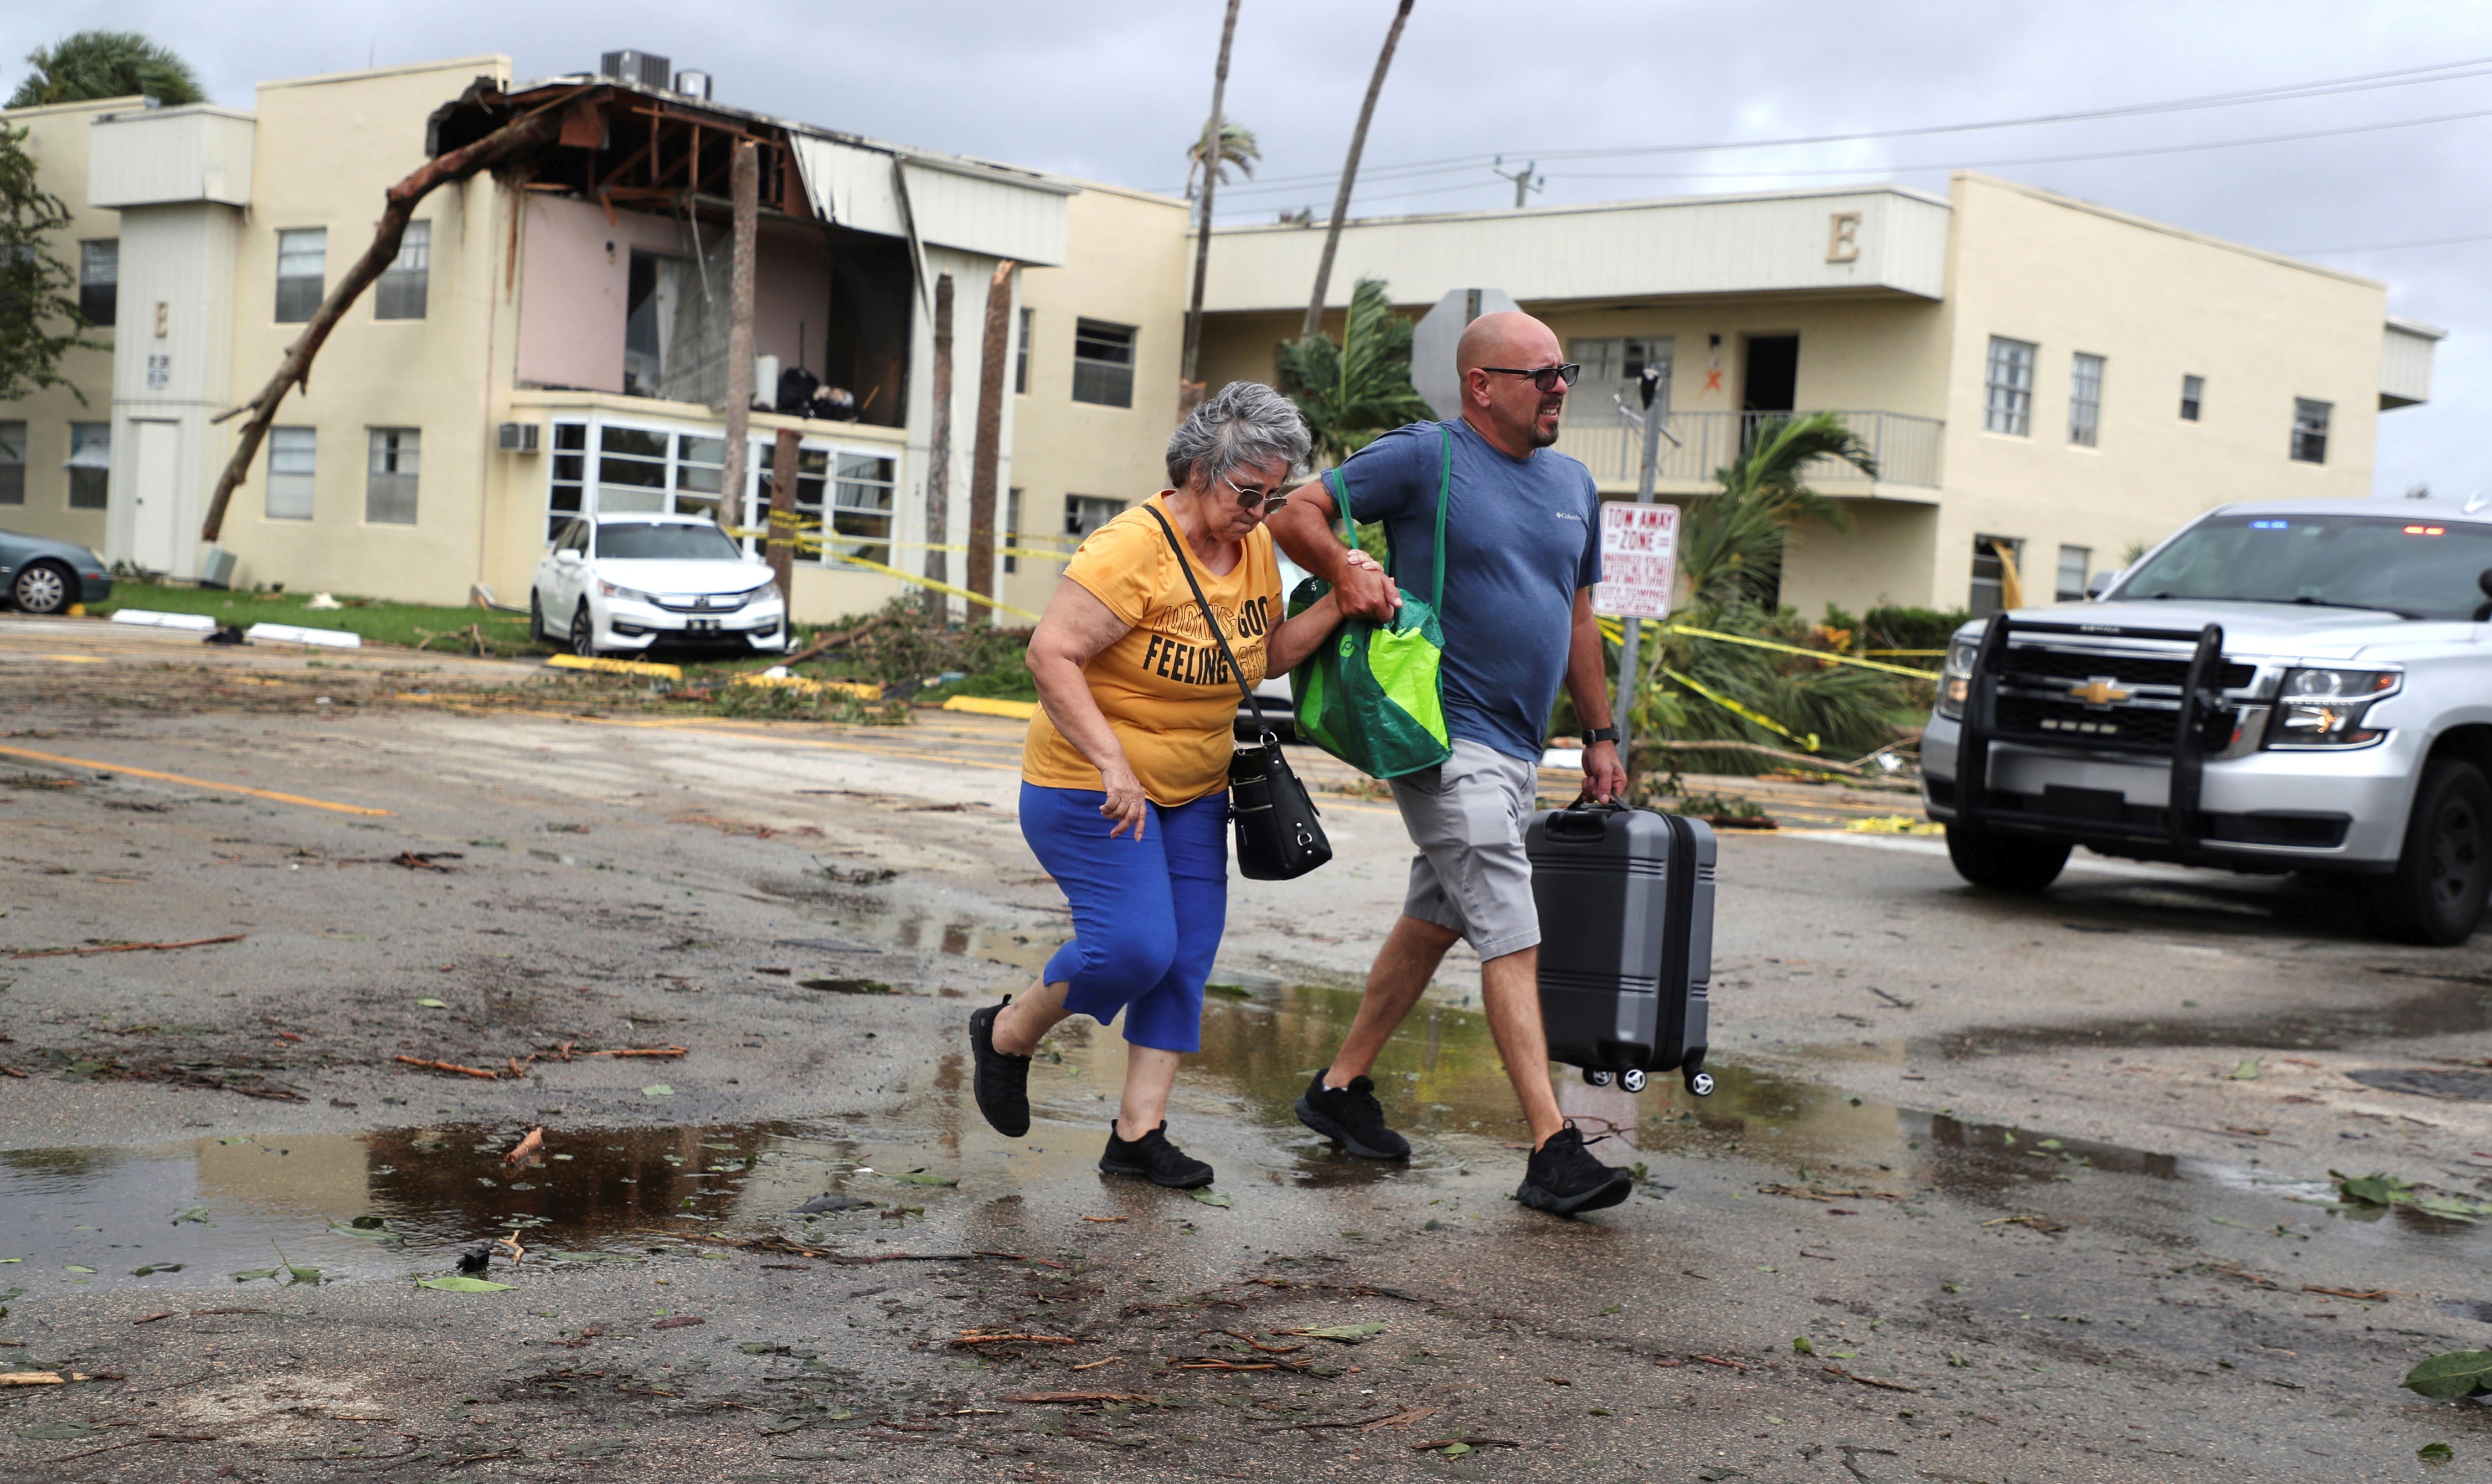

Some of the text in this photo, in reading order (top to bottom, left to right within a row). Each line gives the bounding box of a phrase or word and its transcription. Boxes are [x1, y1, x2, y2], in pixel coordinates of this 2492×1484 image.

[1826, 213, 1861, 263] E
[1608, 509, 1671, 530] TOW AWAY
[1619, 530, 1653, 551] ZONE
[1238, 596, 1268, 638] GOO
[1143, 634, 1266, 684] FEELING GRE
